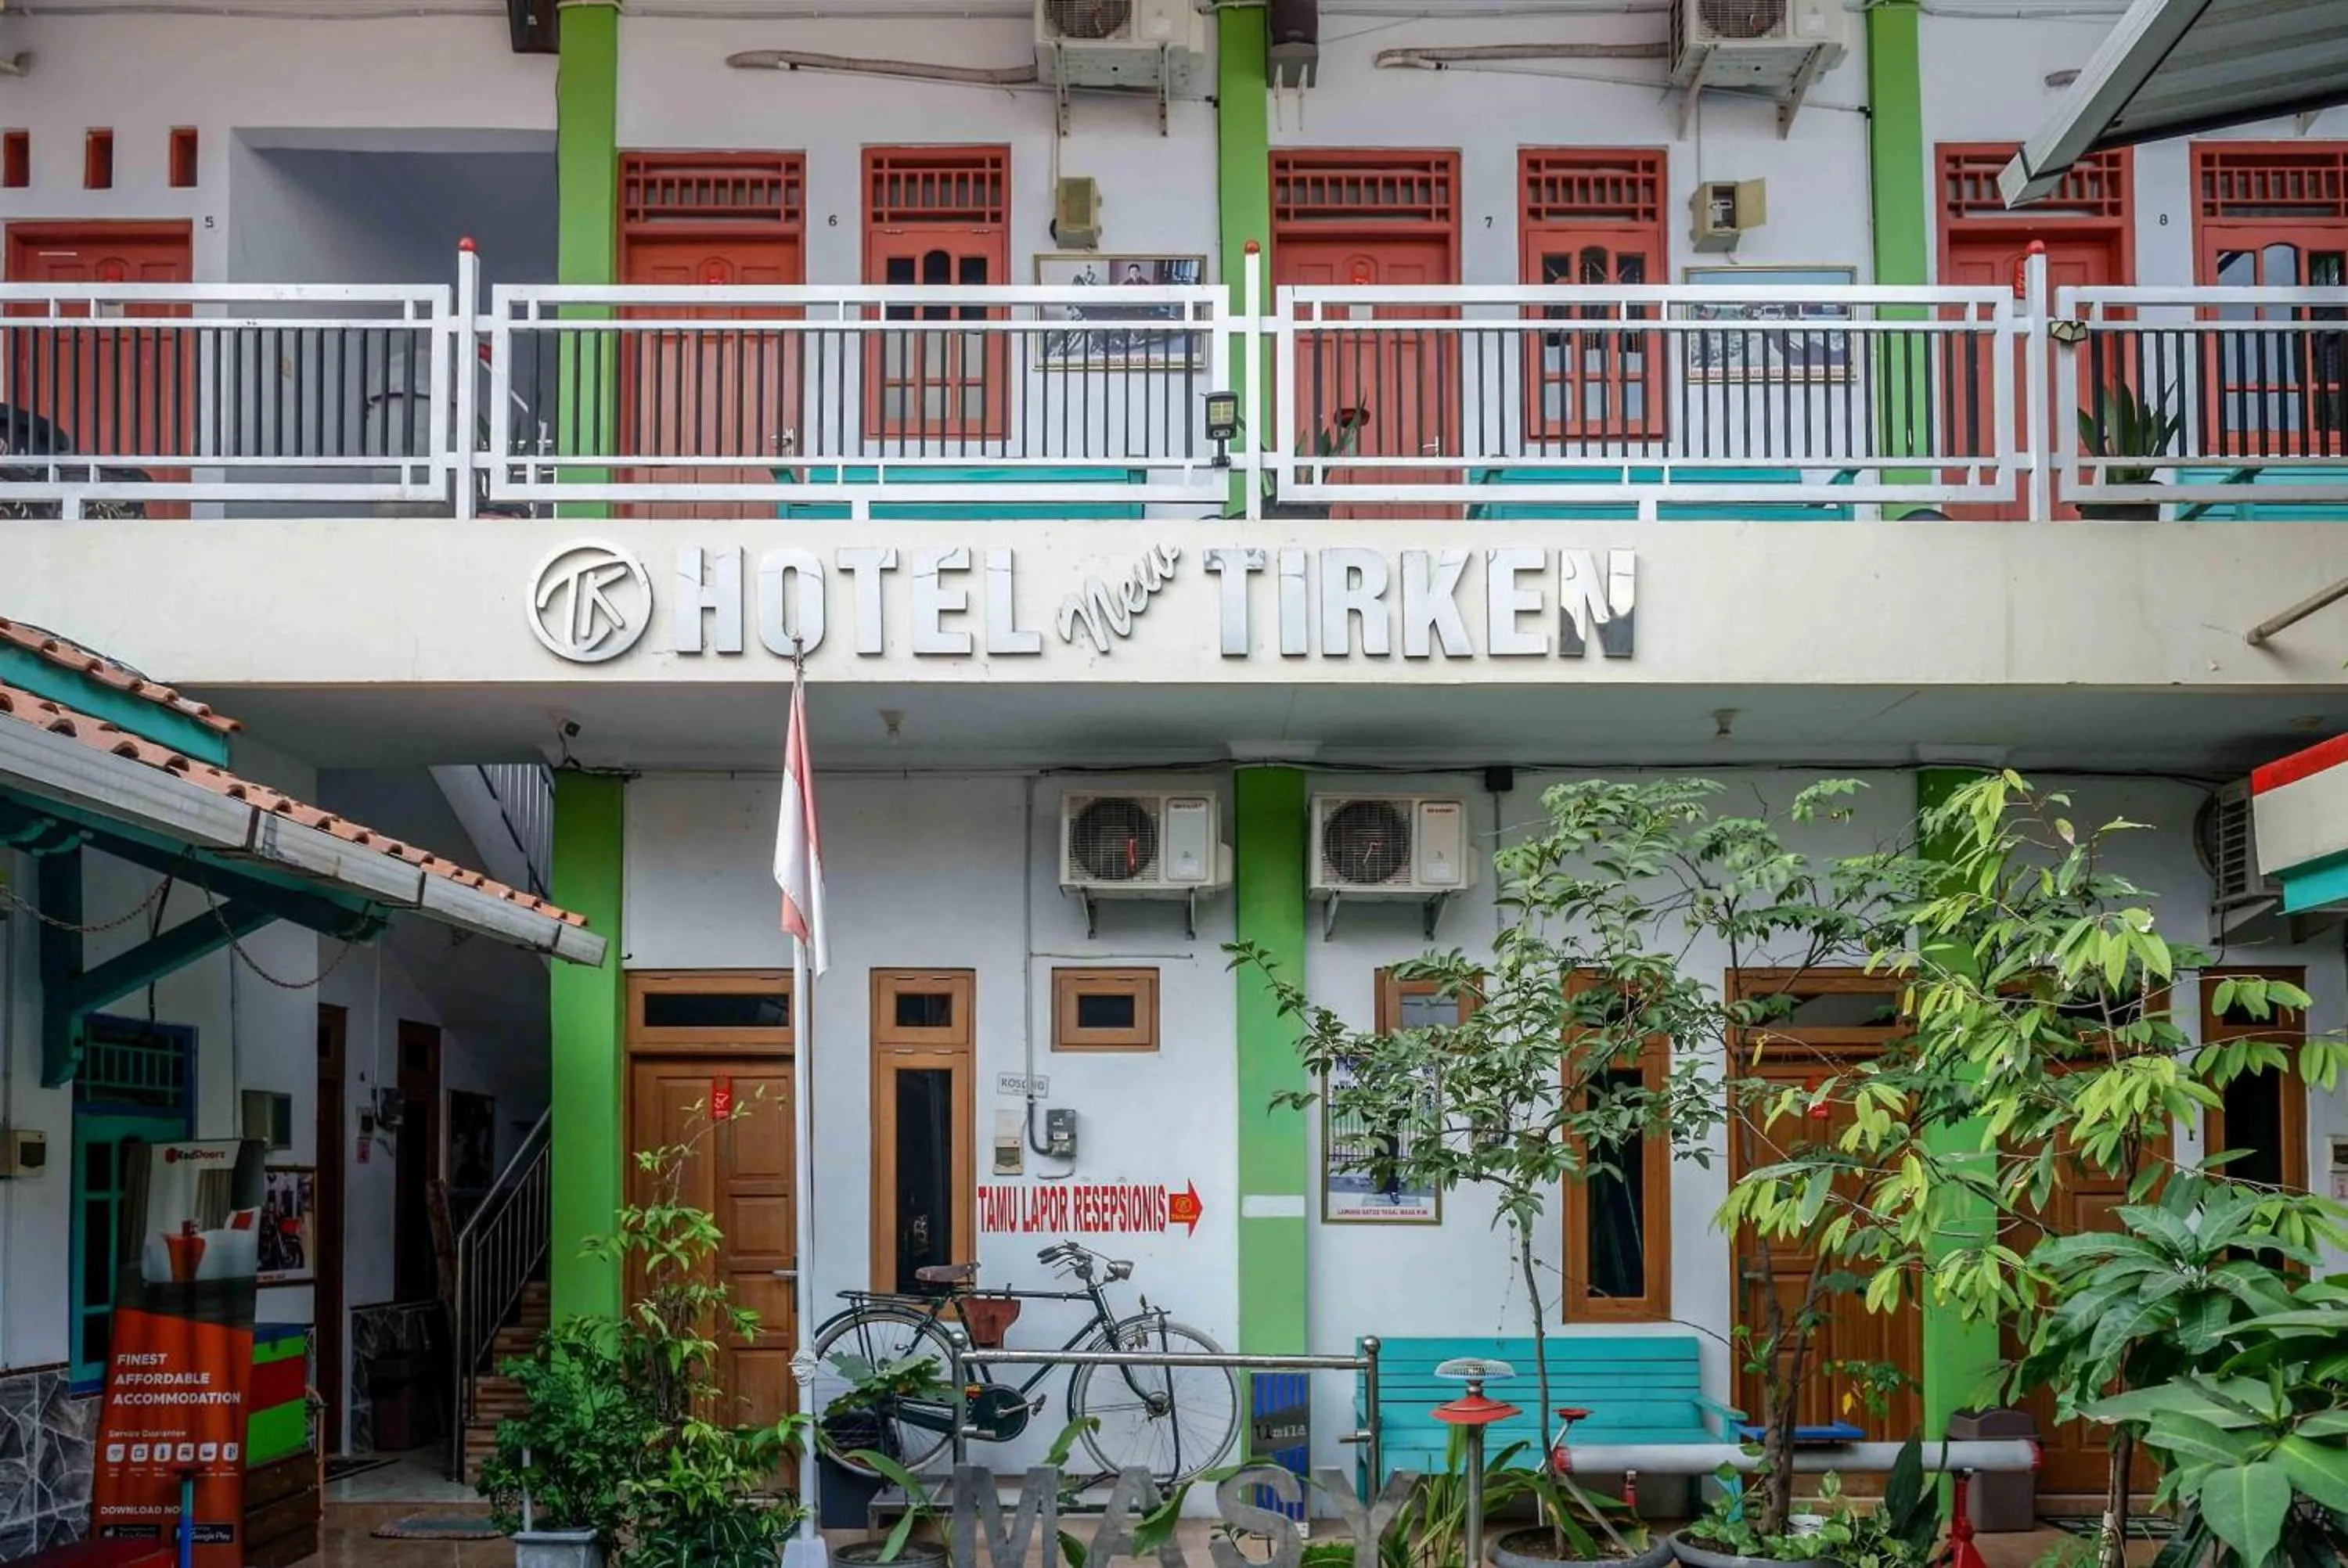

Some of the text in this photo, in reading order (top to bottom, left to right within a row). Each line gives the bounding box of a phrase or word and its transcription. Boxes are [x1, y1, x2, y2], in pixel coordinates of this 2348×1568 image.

[205, 215, 214, 228] 5
[828, 214, 837, 227] 6
[1484, 216, 1493, 228] 7
[2159, 214, 2168, 226] 8
[676, 542, 1637, 659] HOTEL New TIRKEN
[978, 1185, 1166, 1233] TAMU LAPOR RESEPSIONIS
[117, 1354, 168, 1365] FINEST
[114, 1372, 211, 1386] AFFORDABLE
[113, 1391, 241, 1405] ACCOMMODATION
[142, 1430, 187, 1438] Guarantee
[100, 1505, 182, 1515] DOWNLOAD NO
